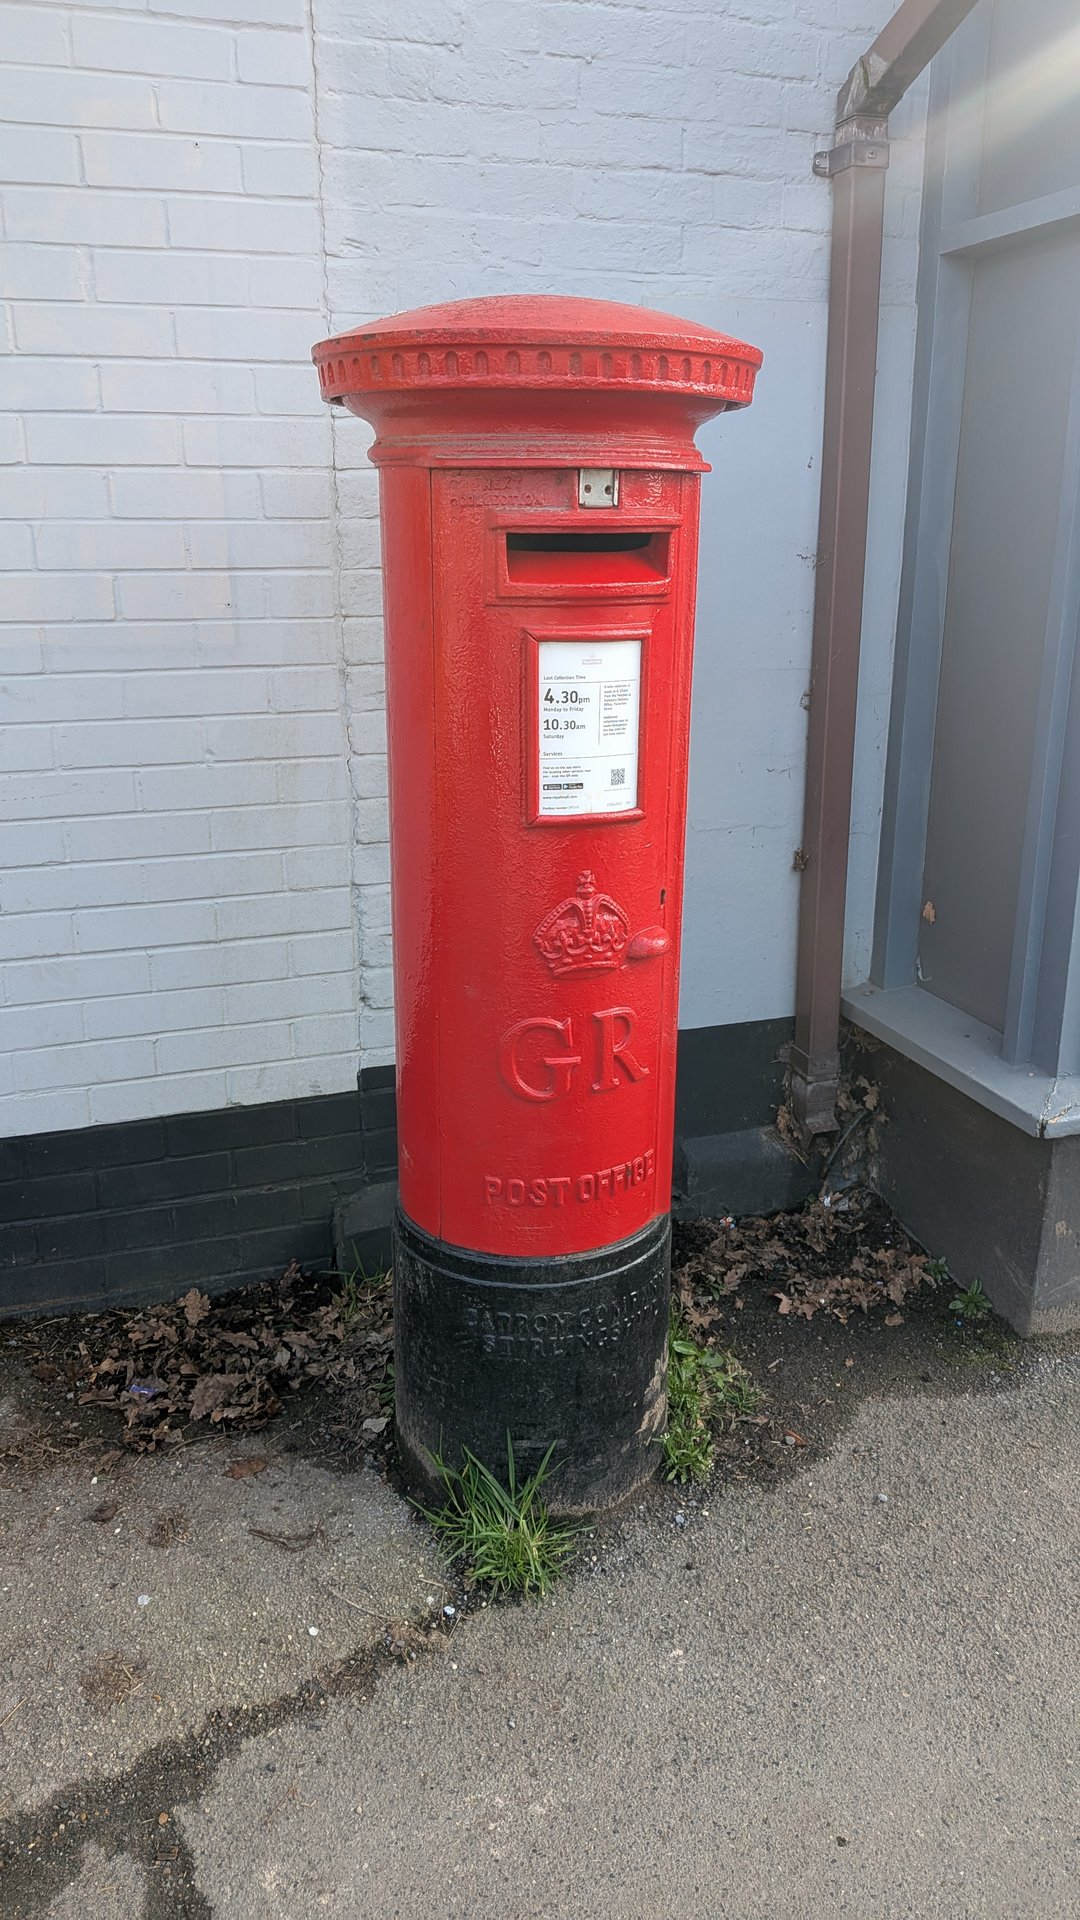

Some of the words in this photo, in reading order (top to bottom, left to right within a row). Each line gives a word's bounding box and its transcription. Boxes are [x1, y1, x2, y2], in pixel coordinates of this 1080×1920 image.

[543, 687, 591, 705] 4.30pm
[543, 718, 586, 731] 10.30am
[484, 1176, 571, 1205] POST
[576, 1149, 655, 1201] OFFICE
